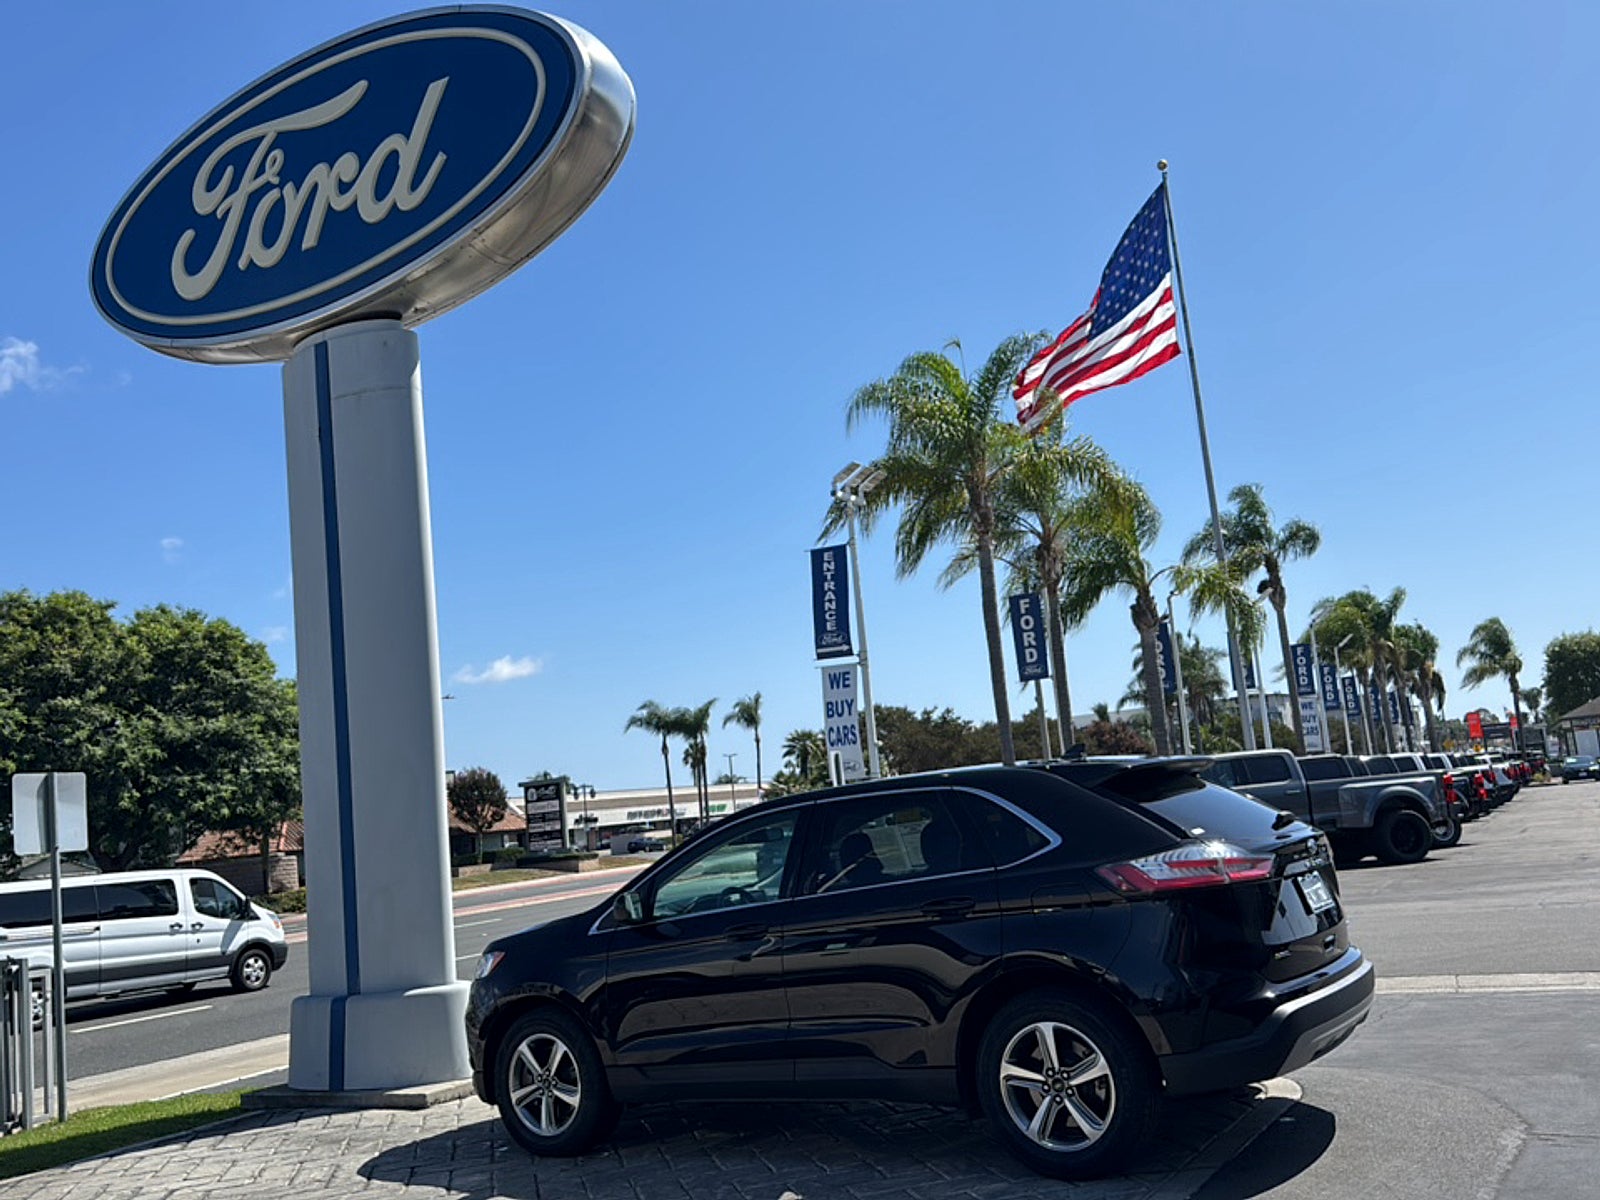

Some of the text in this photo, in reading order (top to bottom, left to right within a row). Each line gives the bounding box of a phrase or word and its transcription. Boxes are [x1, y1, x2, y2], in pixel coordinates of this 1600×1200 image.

[171, 76, 450, 300] Ford
[823, 551, 836, 631] ENTRANCE
[1019, 598, 1037, 663] FORD
[1155, 632, 1166, 679] ORD
[1297, 647, 1308, 685] FORD
[828, 671, 851, 690] WE
[1323, 667, 1334, 700] FORD
[826, 699, 855, 719] BUY
[828, 724, 858, 747] CARS
